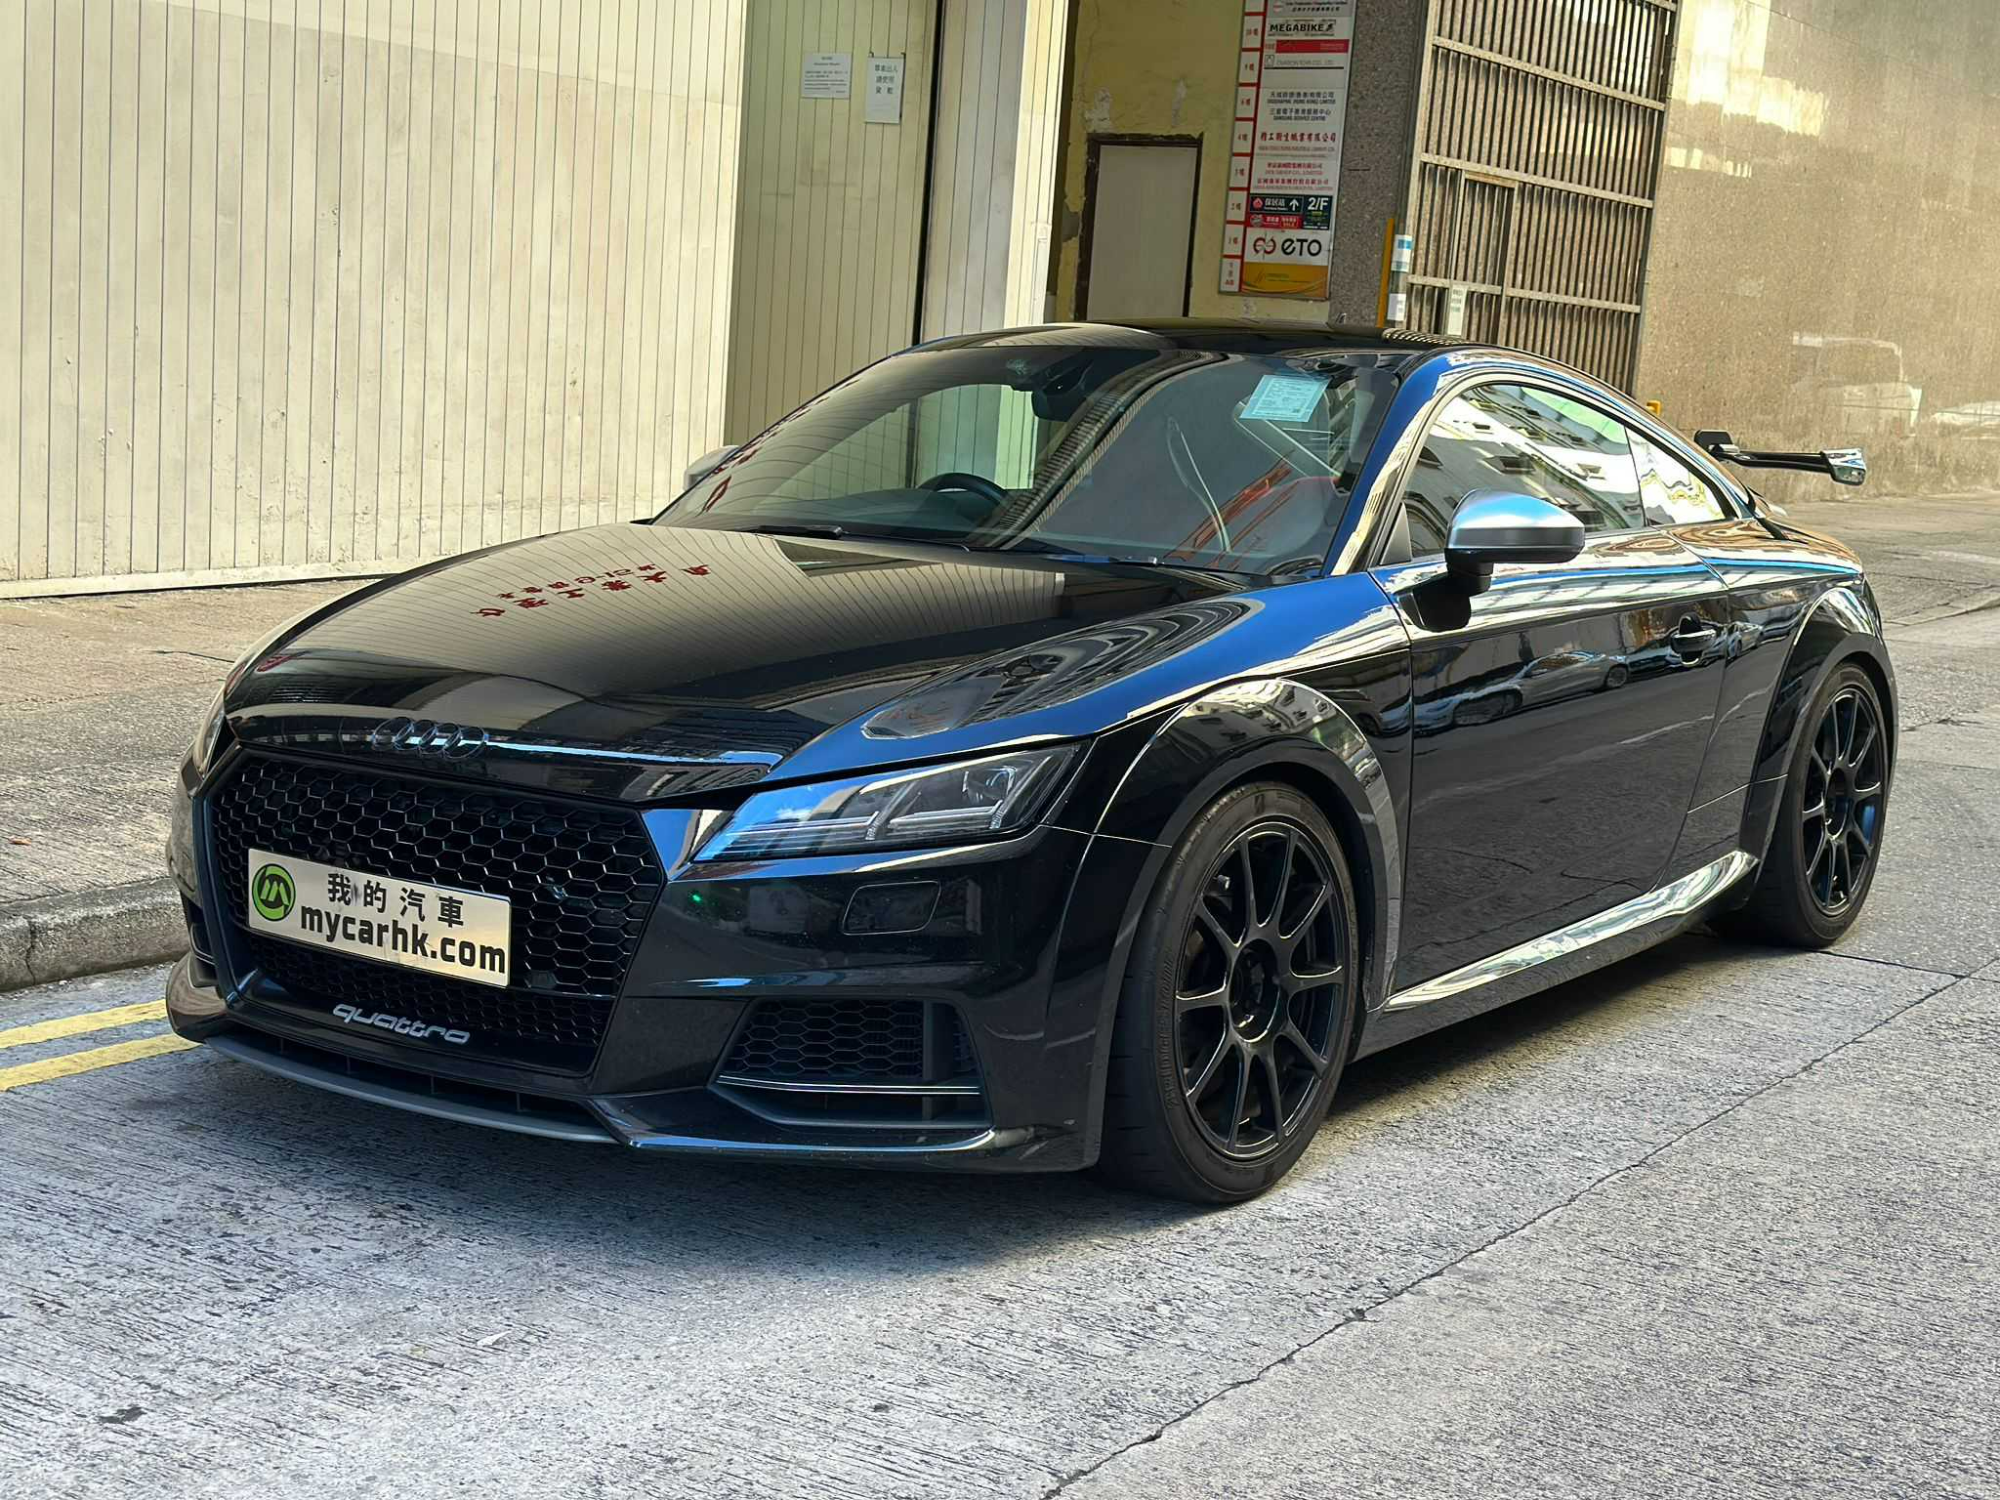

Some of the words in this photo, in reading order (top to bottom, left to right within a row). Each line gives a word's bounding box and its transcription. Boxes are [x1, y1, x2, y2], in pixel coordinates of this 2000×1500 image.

[1269, 23, 1324, 32] MEGABIKE
[1307, 197, 1329, 211] 2/F
[327, 872, 464, 928] 我的汽車
[301, 905, 506, 974] mycarhk.com
[332, 1003, 471, 1045] quattro
